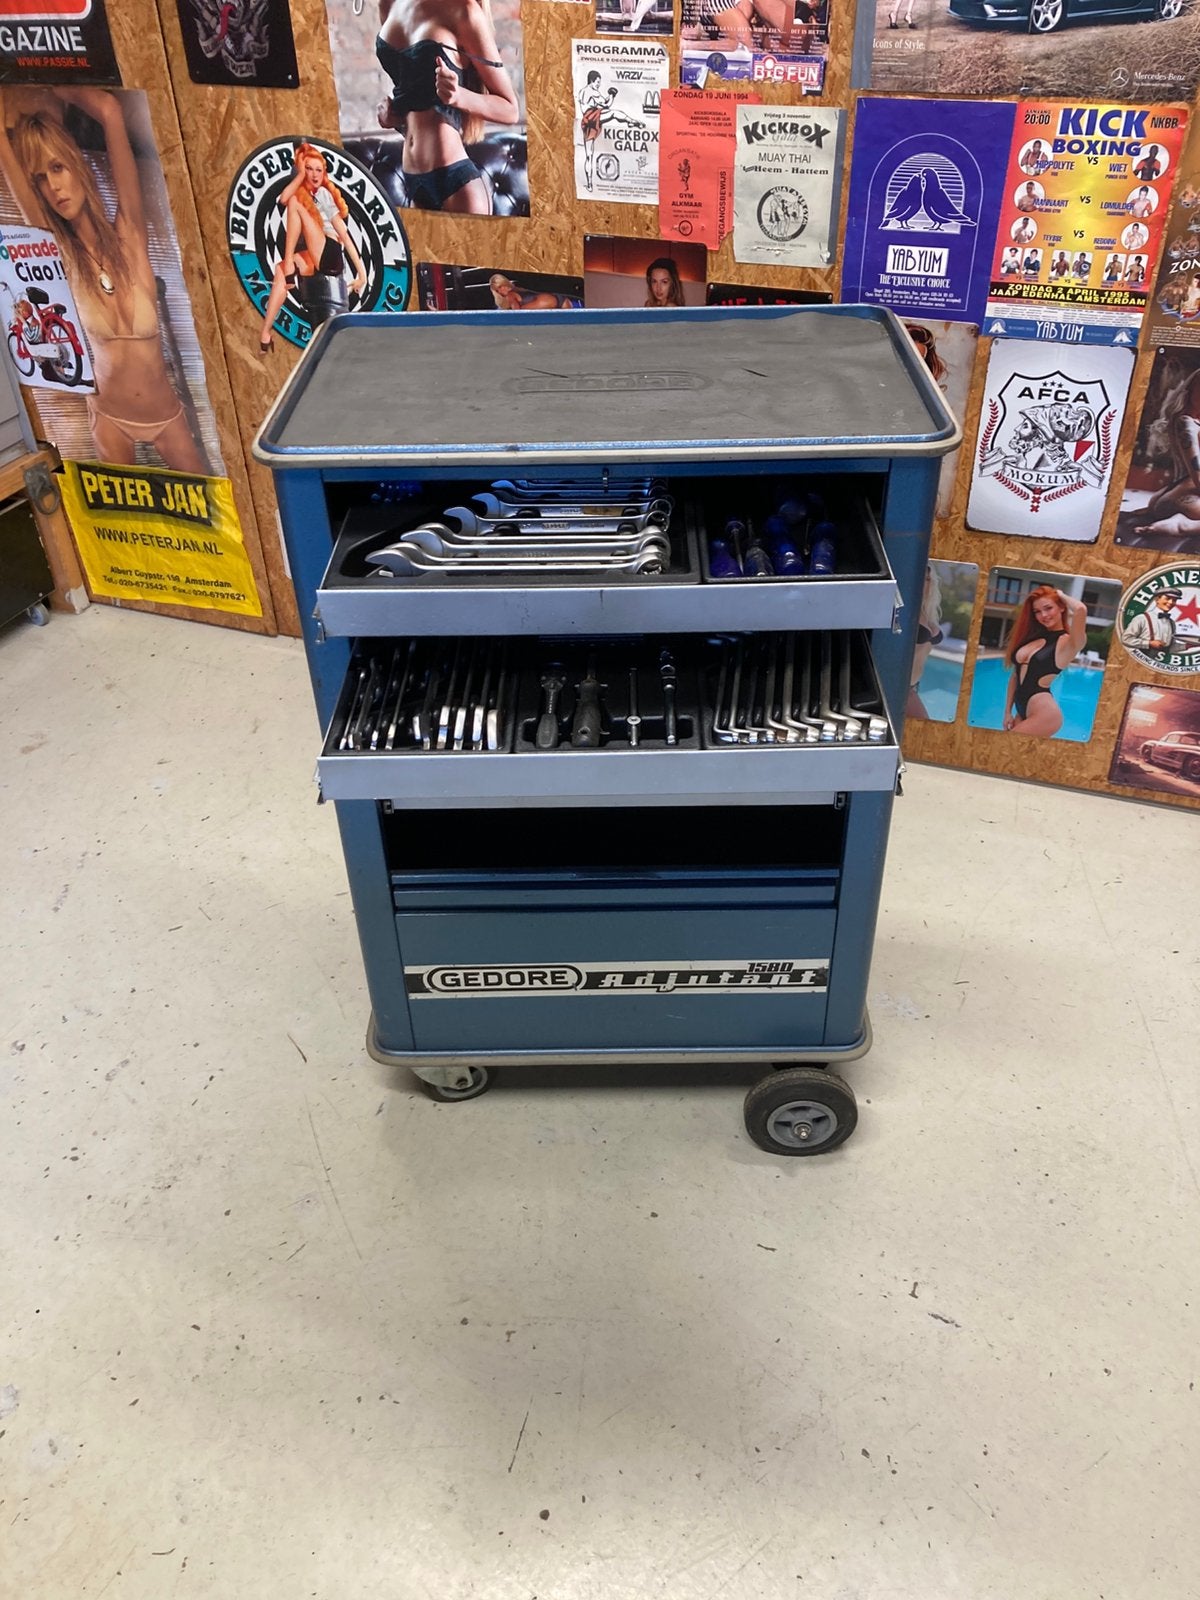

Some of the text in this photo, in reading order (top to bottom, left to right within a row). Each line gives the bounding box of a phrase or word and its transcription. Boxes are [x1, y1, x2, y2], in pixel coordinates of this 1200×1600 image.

[0, 26, 87, 52] GAZINE
[872, 38, 893, 49] Icons
[894, 39, 904, 49] of
[576, 44, 666, 57] PROGRAMMA
[16, 57, 91, 68] WWW.PASSIE.NL
[615, 70, 643, 81] WRZV
[786, 65, 819, 81] FUN
[1133, 71, 1186, 81] Mercedes-Benz
[673, 91, 704, 99] ZONDAG
[715, 92, 732, 100] JUNI
[1024, 114, 1051, 125] 20:00
[1059, 108, 1151, 138] KICK
[604, 128, 660, 143] KICKBOX
[743, 121, 831, 149] KICKBOX
[614, 140, 649, 153] GALA
[1052, 138, 1143, 157] BOXING
[758, 153, 812, 164] MUAY THAI
[1087, 156, 1099, 165] VS
[1109, 163, 1128, 172] WIET
[791, 167, 829, 176] Hattem
[230, 147, 399, 249] BIGGER SPARK
[1079, 195, 1092, 205] VS
[1073, 229, 1085, 239] VS
[892, 247, 944, 273] YAB YUM
[878, 273, 951, 289] THE EXCLUSIVE CHOICE
[990, 288, 1018, 296] JAAP
[1022, 290, 1072, 301] EDENHAL
[1076, 294, 1146, 306] AMSTERDAM
[1007, 283, 1053, 294] ZONDAG
[1057, 287, 1065, 295] 2
[1067, 288, 1099, 297] APRIL
[1036, 321, 1085, 341] YAB YUM
[1017, 386, 1090, 404] AFCA
[1006, 470, 1076, 484] MOKUM
[81, 470, 209, 519] PETER JAN
[93, 525, 224, 556] WWW.PETERJAN.NL
[110, 566, 133, 577] Albert
[184, 576, 232, 588] Amsterdam
[747, 961, 794, 973] 1580
[440, 970, 816, 993] GEDORE Adjutant
